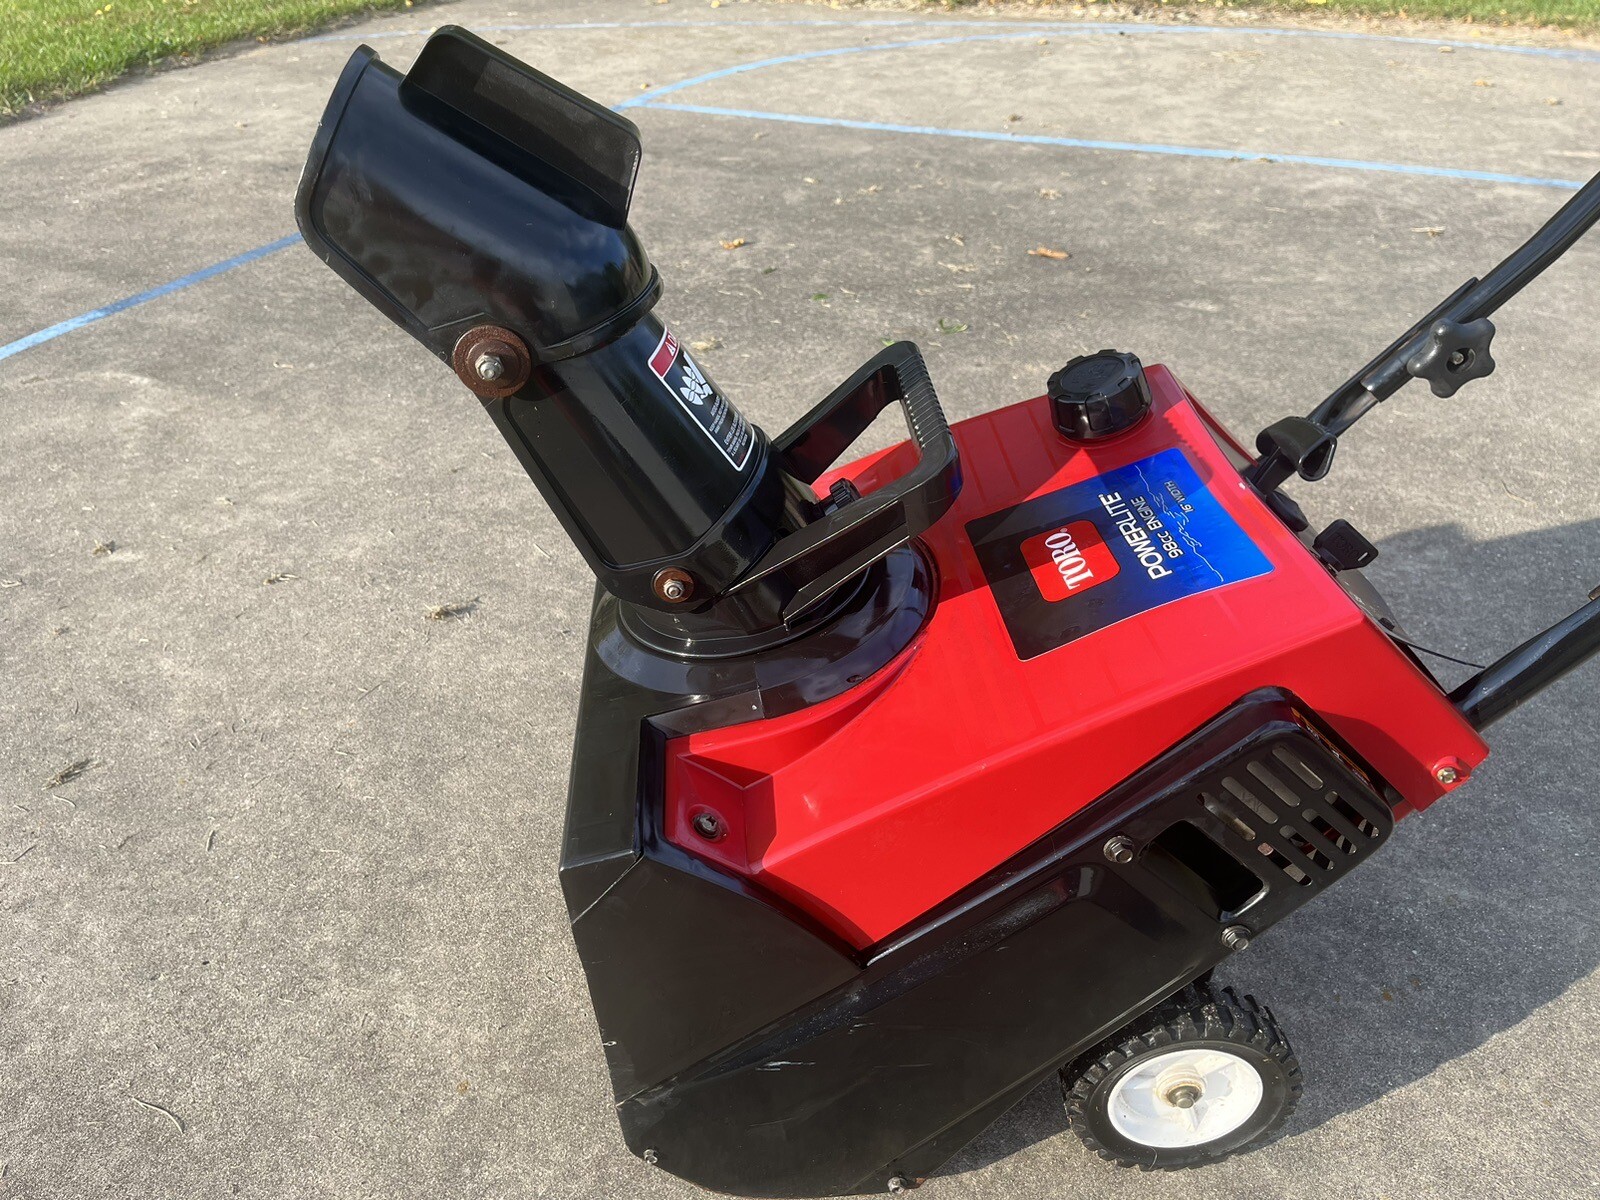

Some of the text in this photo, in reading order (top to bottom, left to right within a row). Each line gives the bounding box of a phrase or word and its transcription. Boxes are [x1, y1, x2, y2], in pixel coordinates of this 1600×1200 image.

[1131, 496, 1163, 531] ENGINE
[1164, 480, 1186, 503] WIDTH
[1100, 491, 1173, 580] POWERLITE
[1045, 531, 1093, 590] TORO
